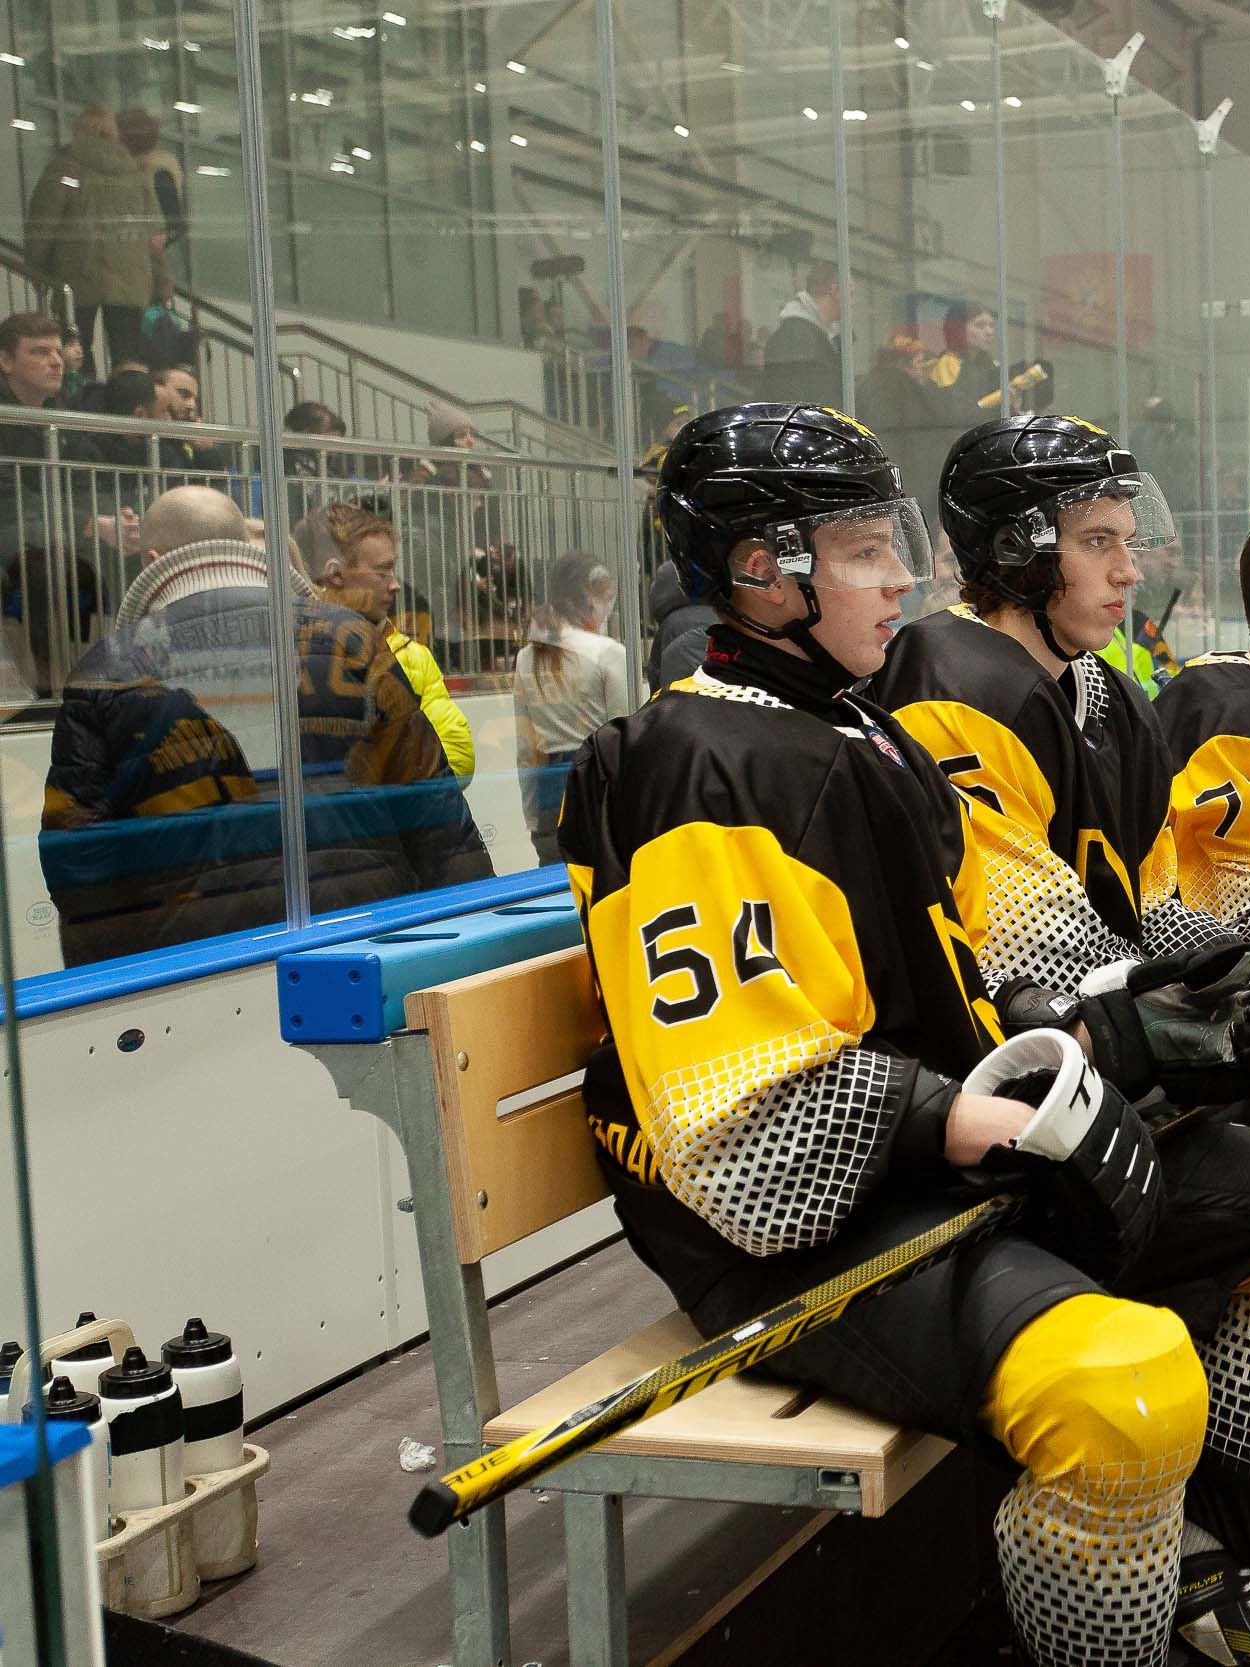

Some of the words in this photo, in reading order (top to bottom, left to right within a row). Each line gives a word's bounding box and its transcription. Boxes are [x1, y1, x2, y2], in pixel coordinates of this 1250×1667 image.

[779, 555, 810, 565] BAUER
[639, 898, 799, 1028] 54
[665, 1302, 846, 1406] TRUE
[442, 1450, 512, 1486] RUE
[1177, 1571, 1224, 1595] TALYST
